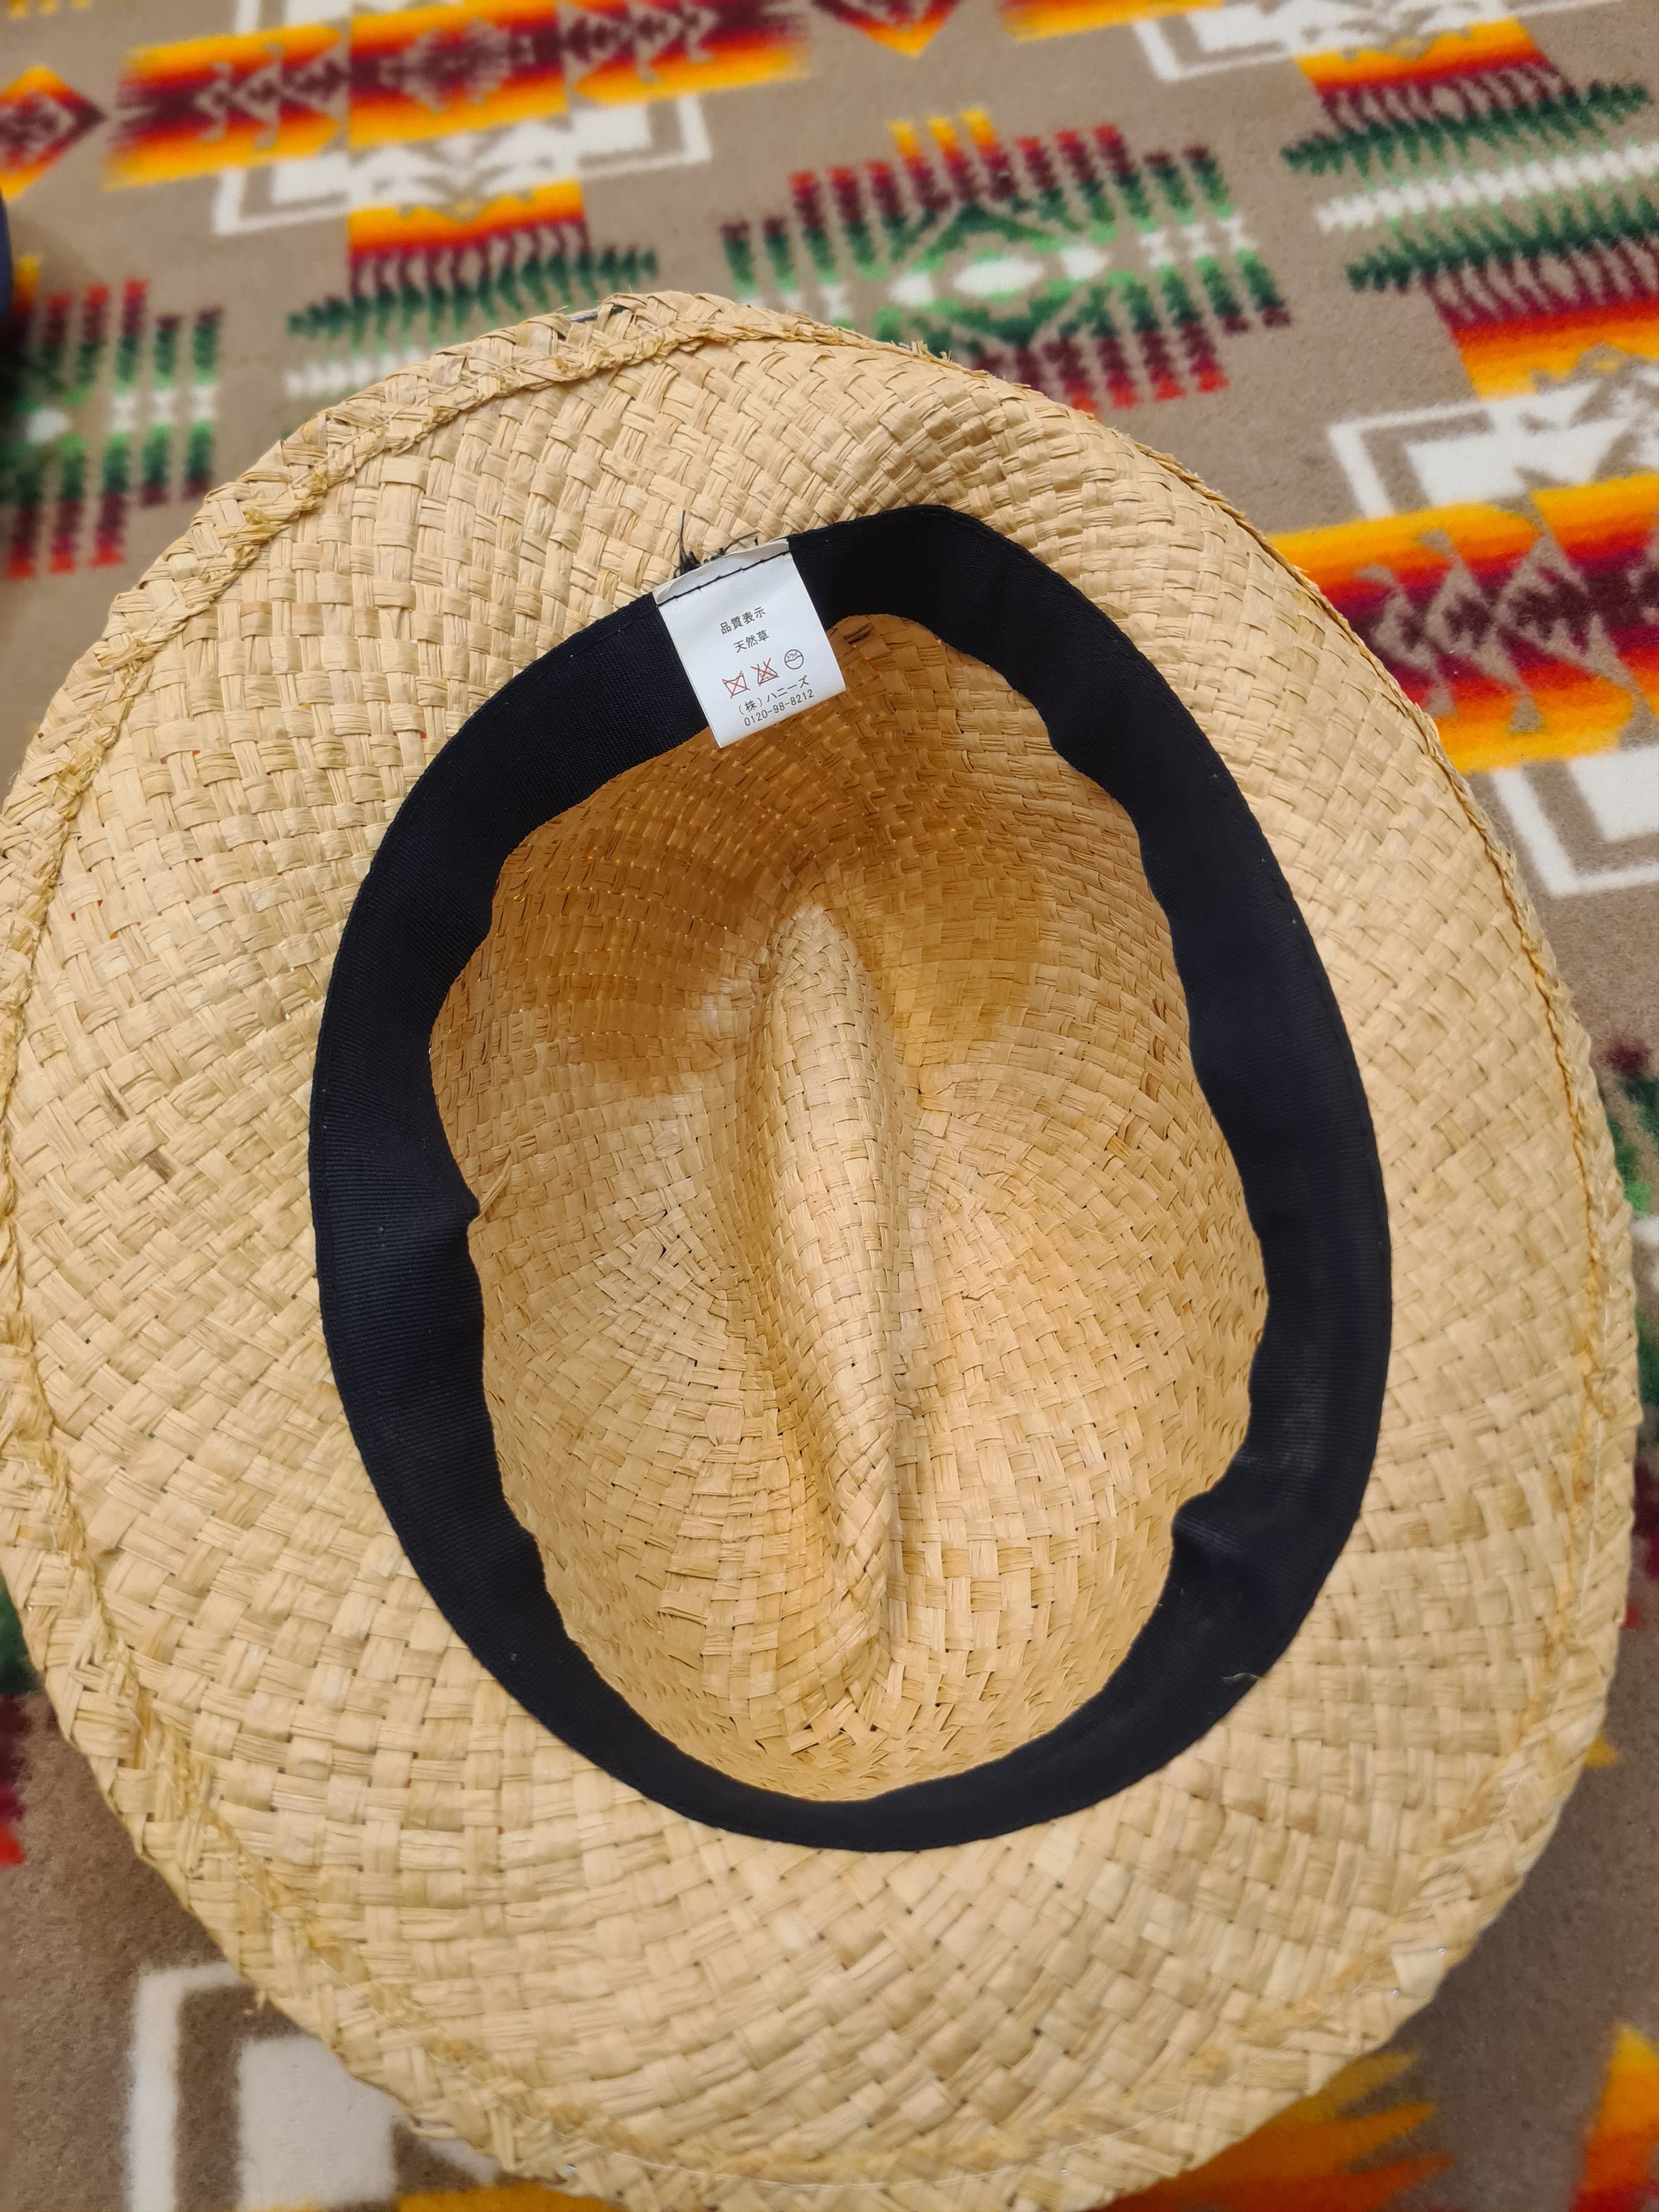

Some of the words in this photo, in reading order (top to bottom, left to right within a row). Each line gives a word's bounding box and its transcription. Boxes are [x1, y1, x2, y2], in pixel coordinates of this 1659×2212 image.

[720, 607, 766, 634] 品質表示
[733, 630, 769, 653] 天然草
[744, 689, 815, 726] 0120-98-8212
